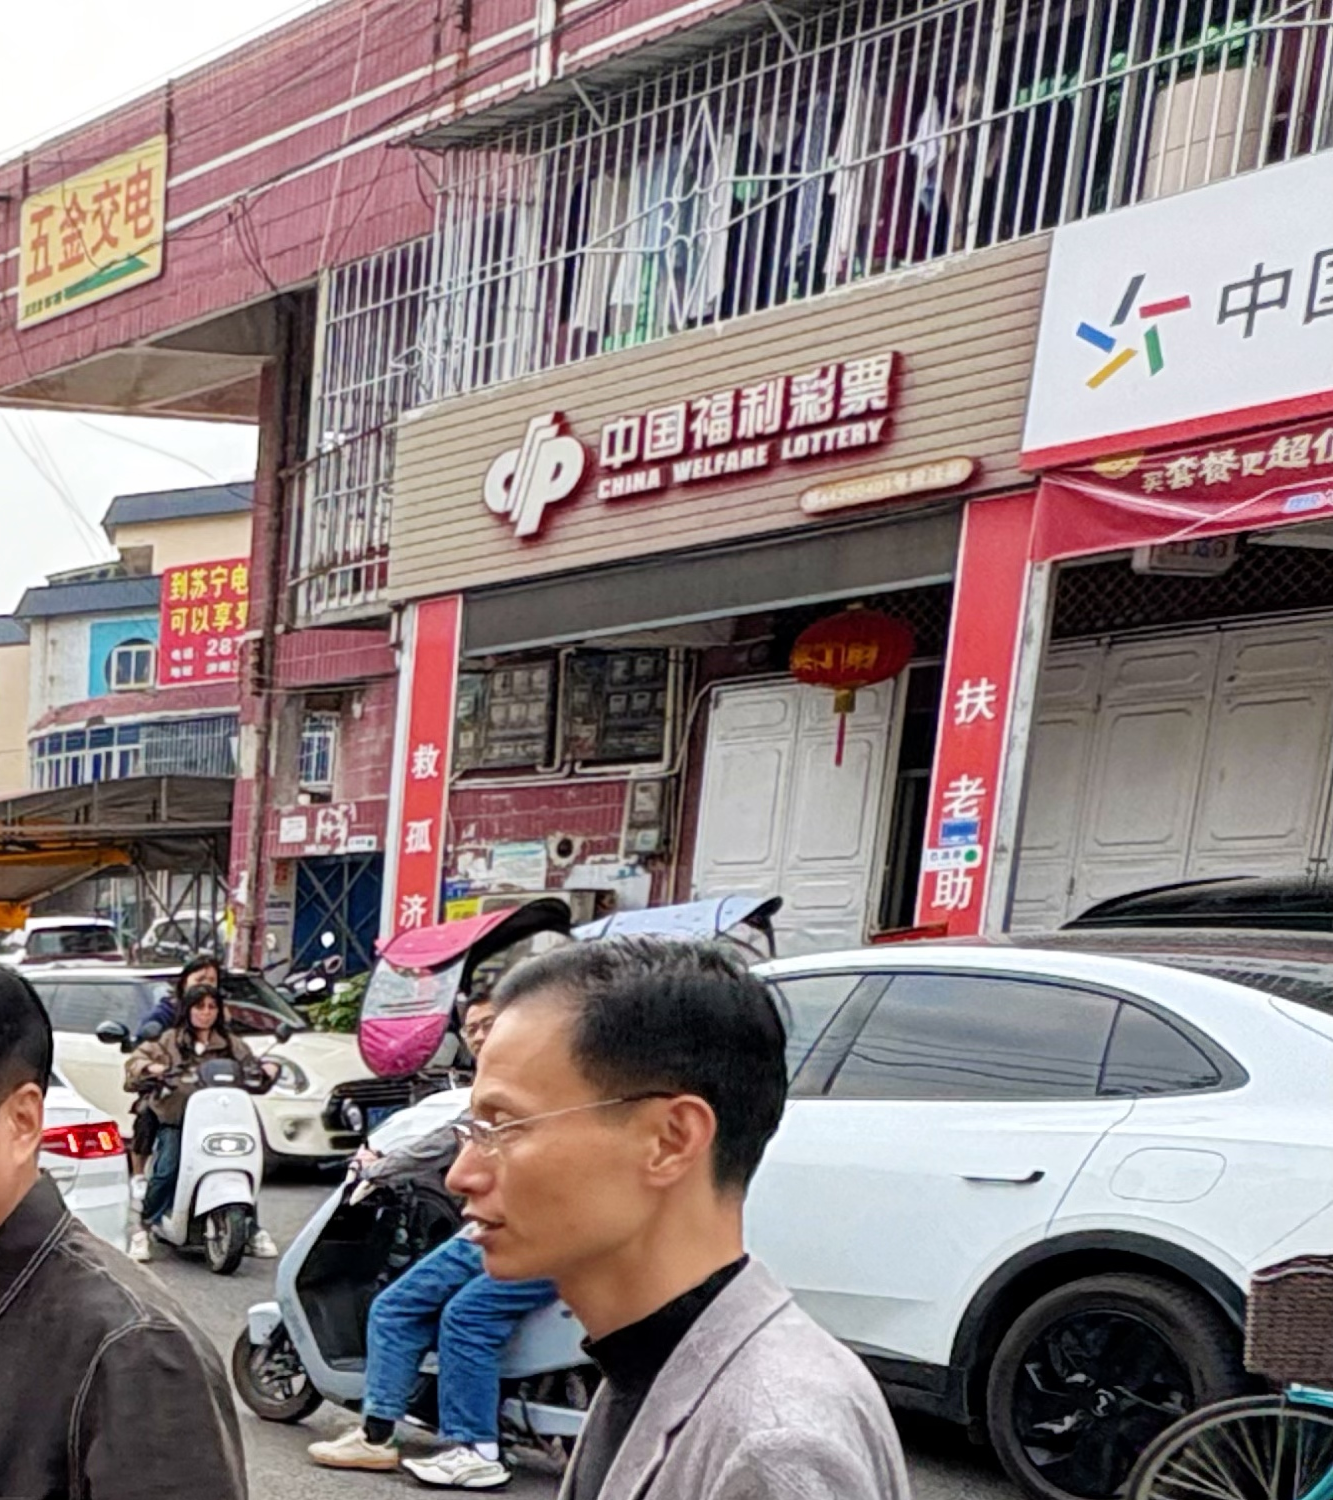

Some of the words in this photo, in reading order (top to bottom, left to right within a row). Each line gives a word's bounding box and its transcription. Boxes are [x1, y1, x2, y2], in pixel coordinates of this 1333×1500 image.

[25, 160, 154, 287] 五金交电
[596, 466, 661, 500] CHINA
[671, 442, 771, 484] WELFARE
[780, 416, 887, 461] LOTTERY
[598, 352, 894, 469] 中国福利彩票
[168, 562, 249, 602] 到苏宁电
[204, 637, 240, 658] 28
[398, 743, 441, 930] 救孤济
[931, 677, 998, 911] 扶老助
